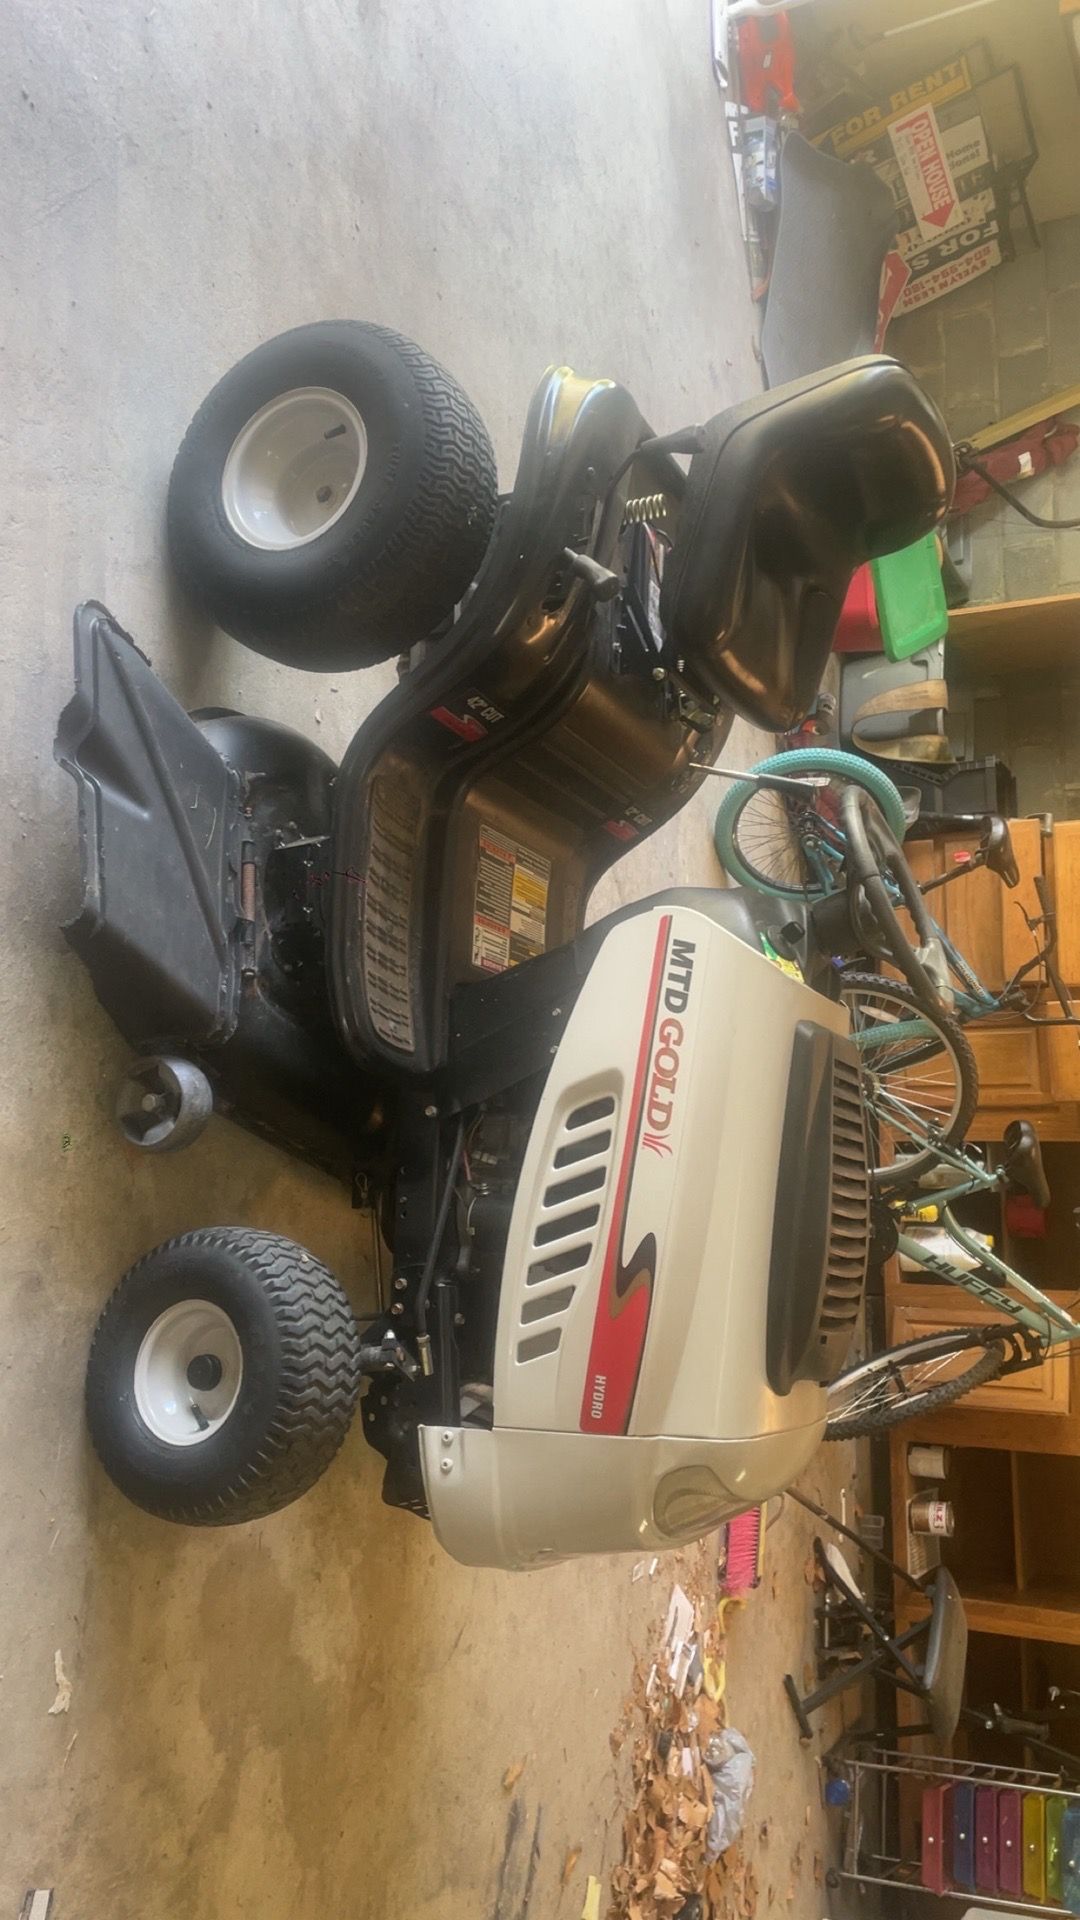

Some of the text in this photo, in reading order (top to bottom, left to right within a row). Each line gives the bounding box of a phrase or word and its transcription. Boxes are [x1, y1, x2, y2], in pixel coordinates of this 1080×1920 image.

[831, 62, 961, 146] FOR RENT
[912, 119, 953, 211] OPEN HOUSE
[937, 219, 999, 256] FOR
[480, 706, 505, 723] CUT
[646, 938, 697, 1132] MTD GOLD
[922, 1254, 1024, 1314] HUFFY
[591, 1374, 607, 1419] HYDRO
